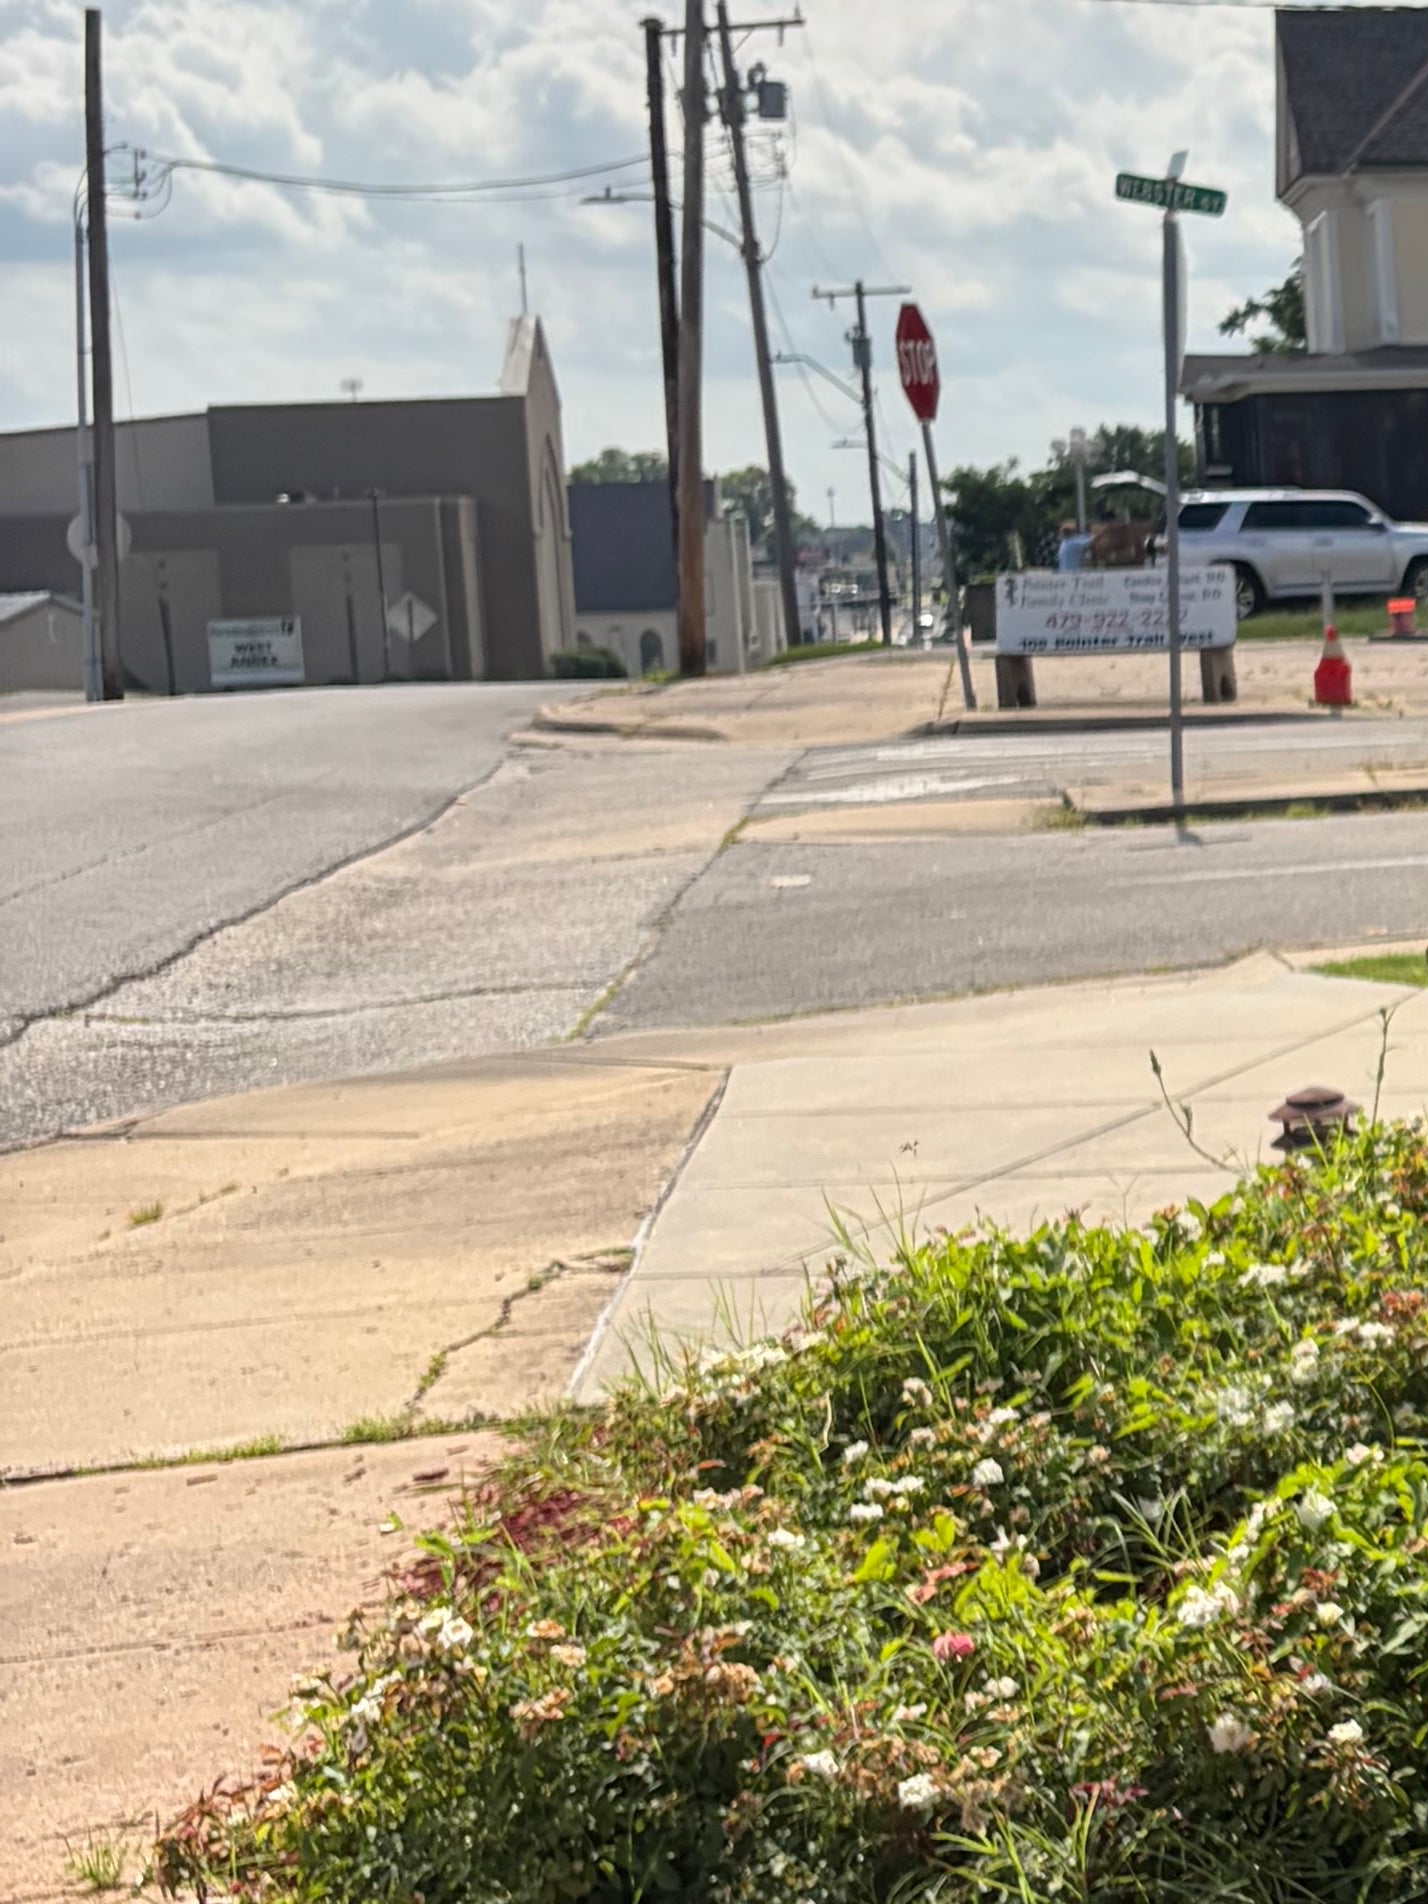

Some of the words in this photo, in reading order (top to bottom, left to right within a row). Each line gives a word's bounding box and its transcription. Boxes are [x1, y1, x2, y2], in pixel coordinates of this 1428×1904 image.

[1119, 176, 1197, 210] WEBSTER
[900, 338, 936, 386] STOP
[1046, 609, 1188, 630] 479-922-222
[1055, 634, 1119, 651] Pointer
[1129, 633, 1164, 647] Trail
